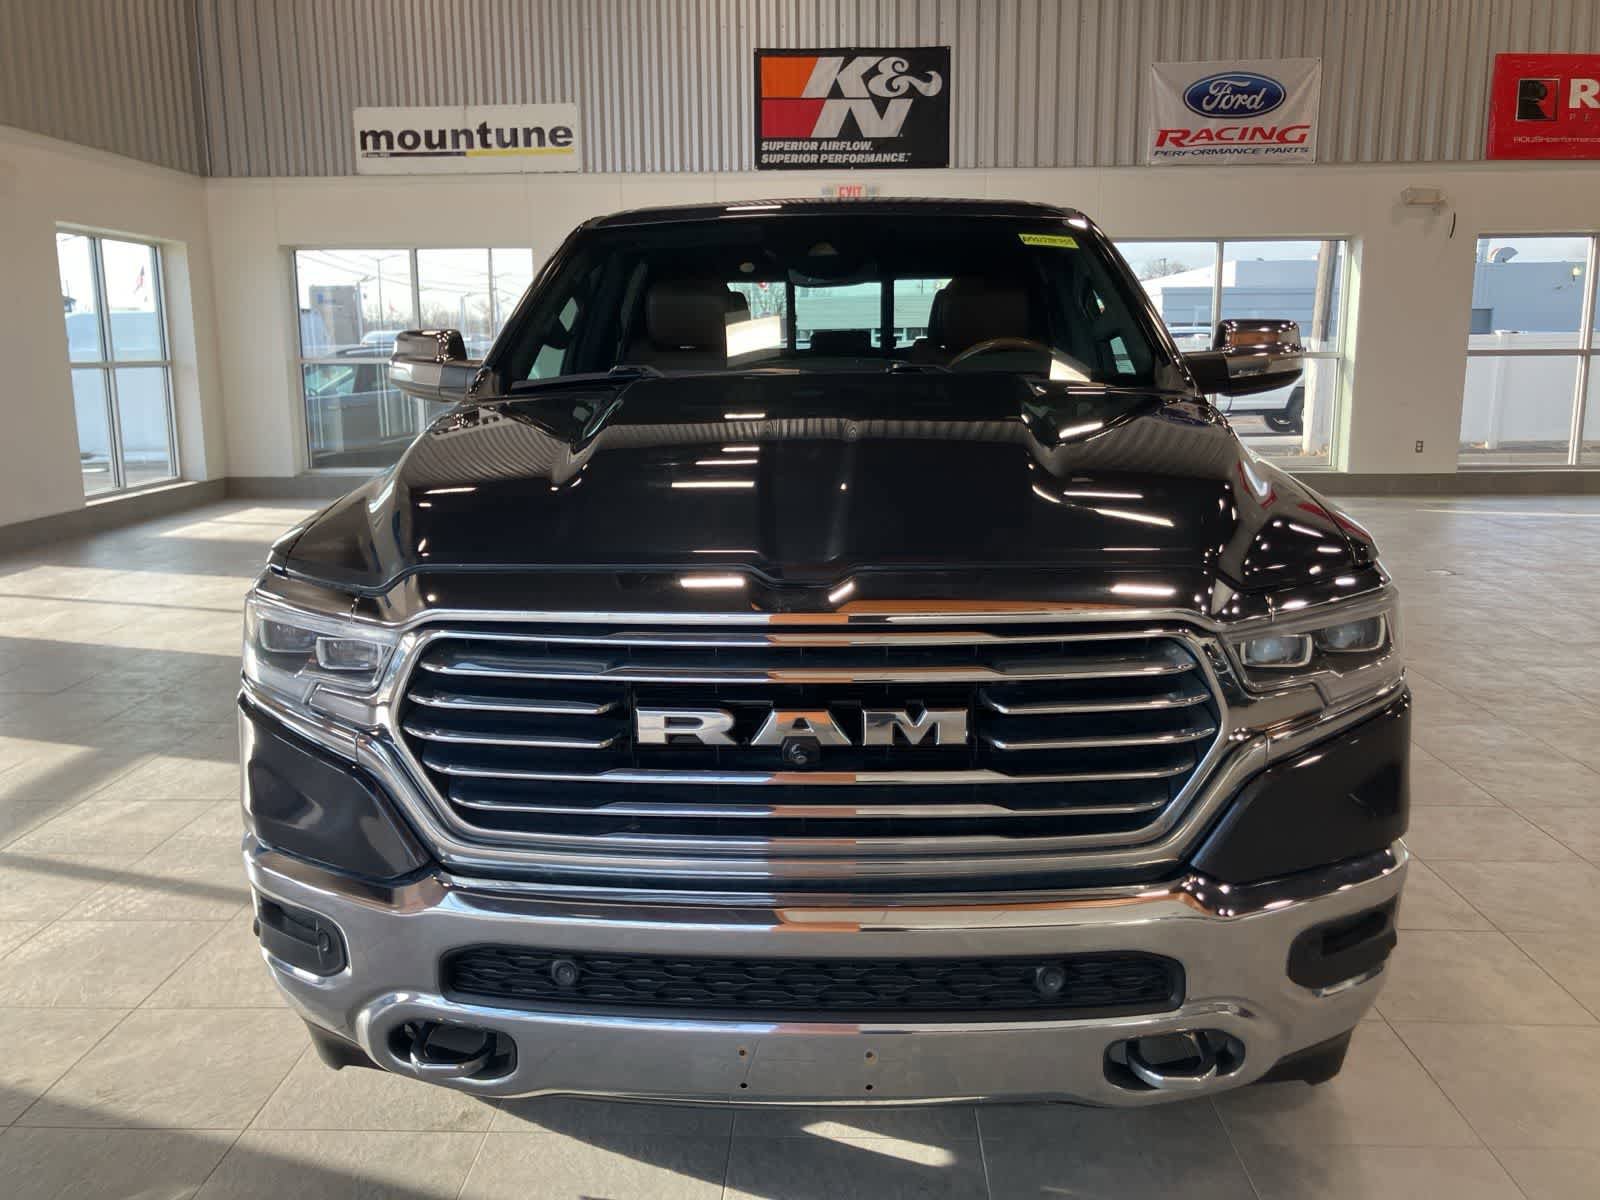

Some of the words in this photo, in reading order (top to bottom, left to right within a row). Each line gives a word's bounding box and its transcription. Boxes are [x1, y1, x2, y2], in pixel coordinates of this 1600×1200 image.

[1202, 80, 1267, 111] Ford
[359, 120, 573, 150] mountune
[761, 141, 818, 151] SUPERIOR
[820, 140, 874, 151] AIRFLOW.
[1155, 125, 1312, 149] RACING
[761, 154, 819, 164] SUPERIOR
[1153, 147, 1261, 157] PERFORMANCE
[1264, 146, 1310, 156] PARTS
[635, 708, 968, 746] RAM
